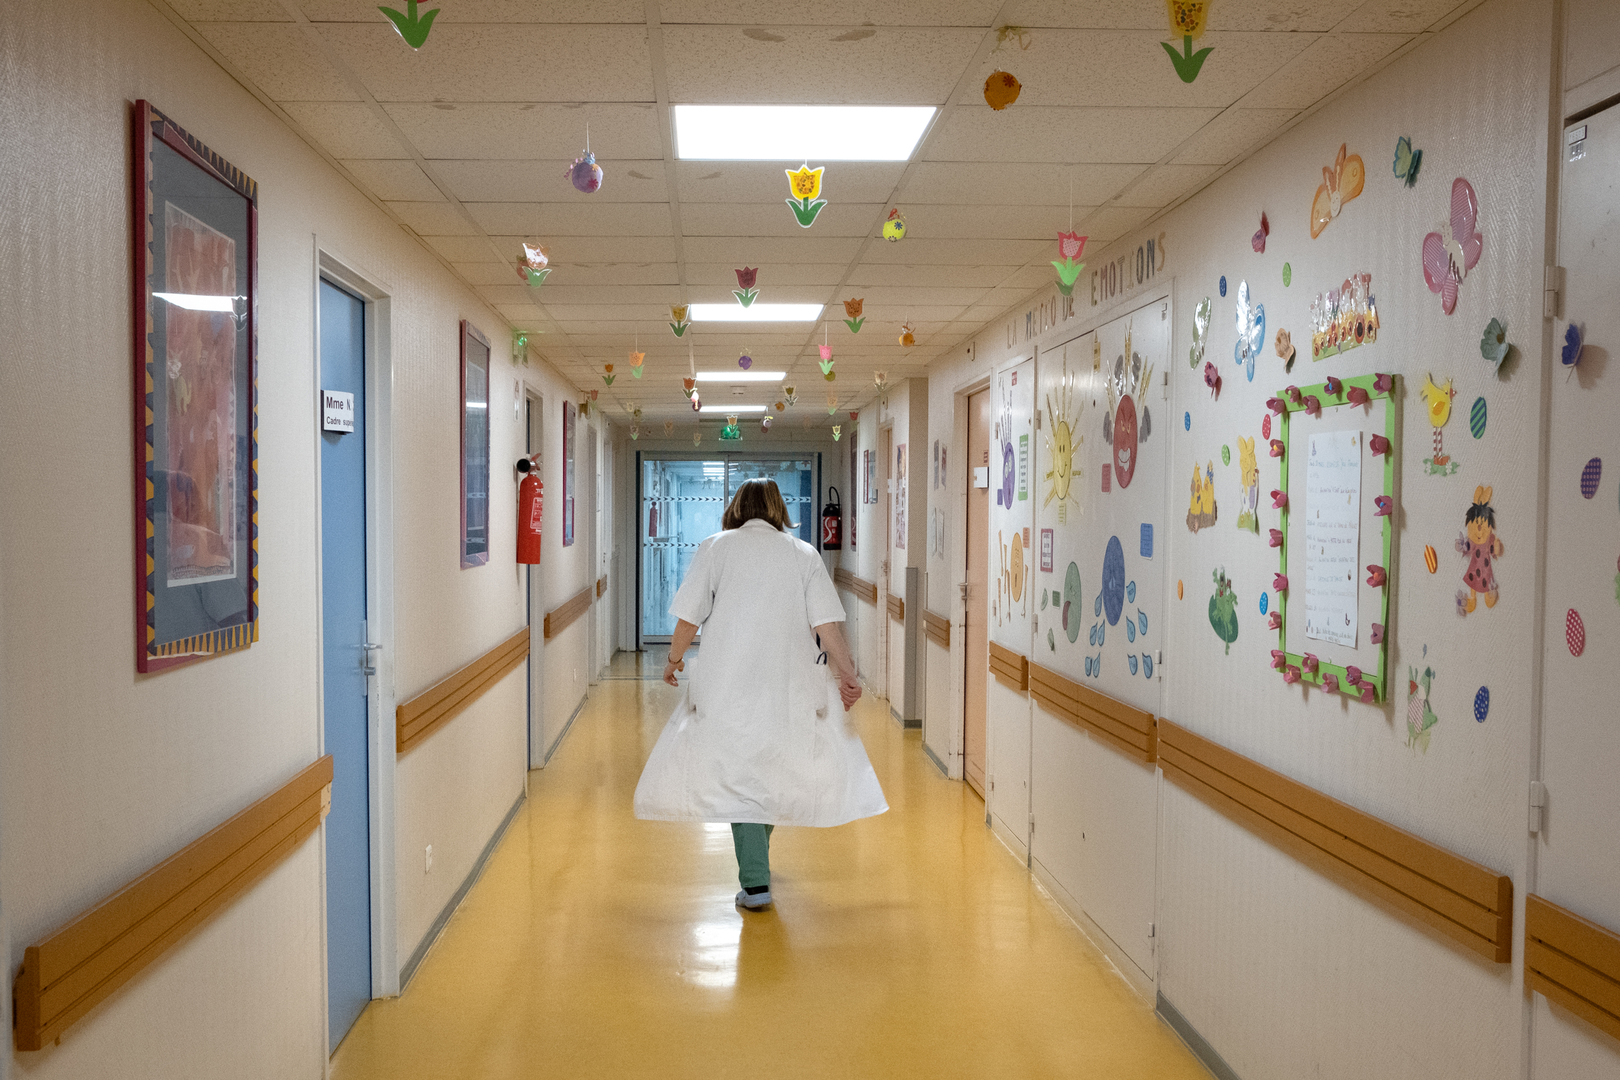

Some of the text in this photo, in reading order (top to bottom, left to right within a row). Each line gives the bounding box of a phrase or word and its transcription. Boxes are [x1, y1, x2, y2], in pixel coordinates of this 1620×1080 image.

[1091, 232, 1166, 306] EMOTIONS
[326, 396, 344, 410] Mme
[326, 416, 340, 425] Cadre
